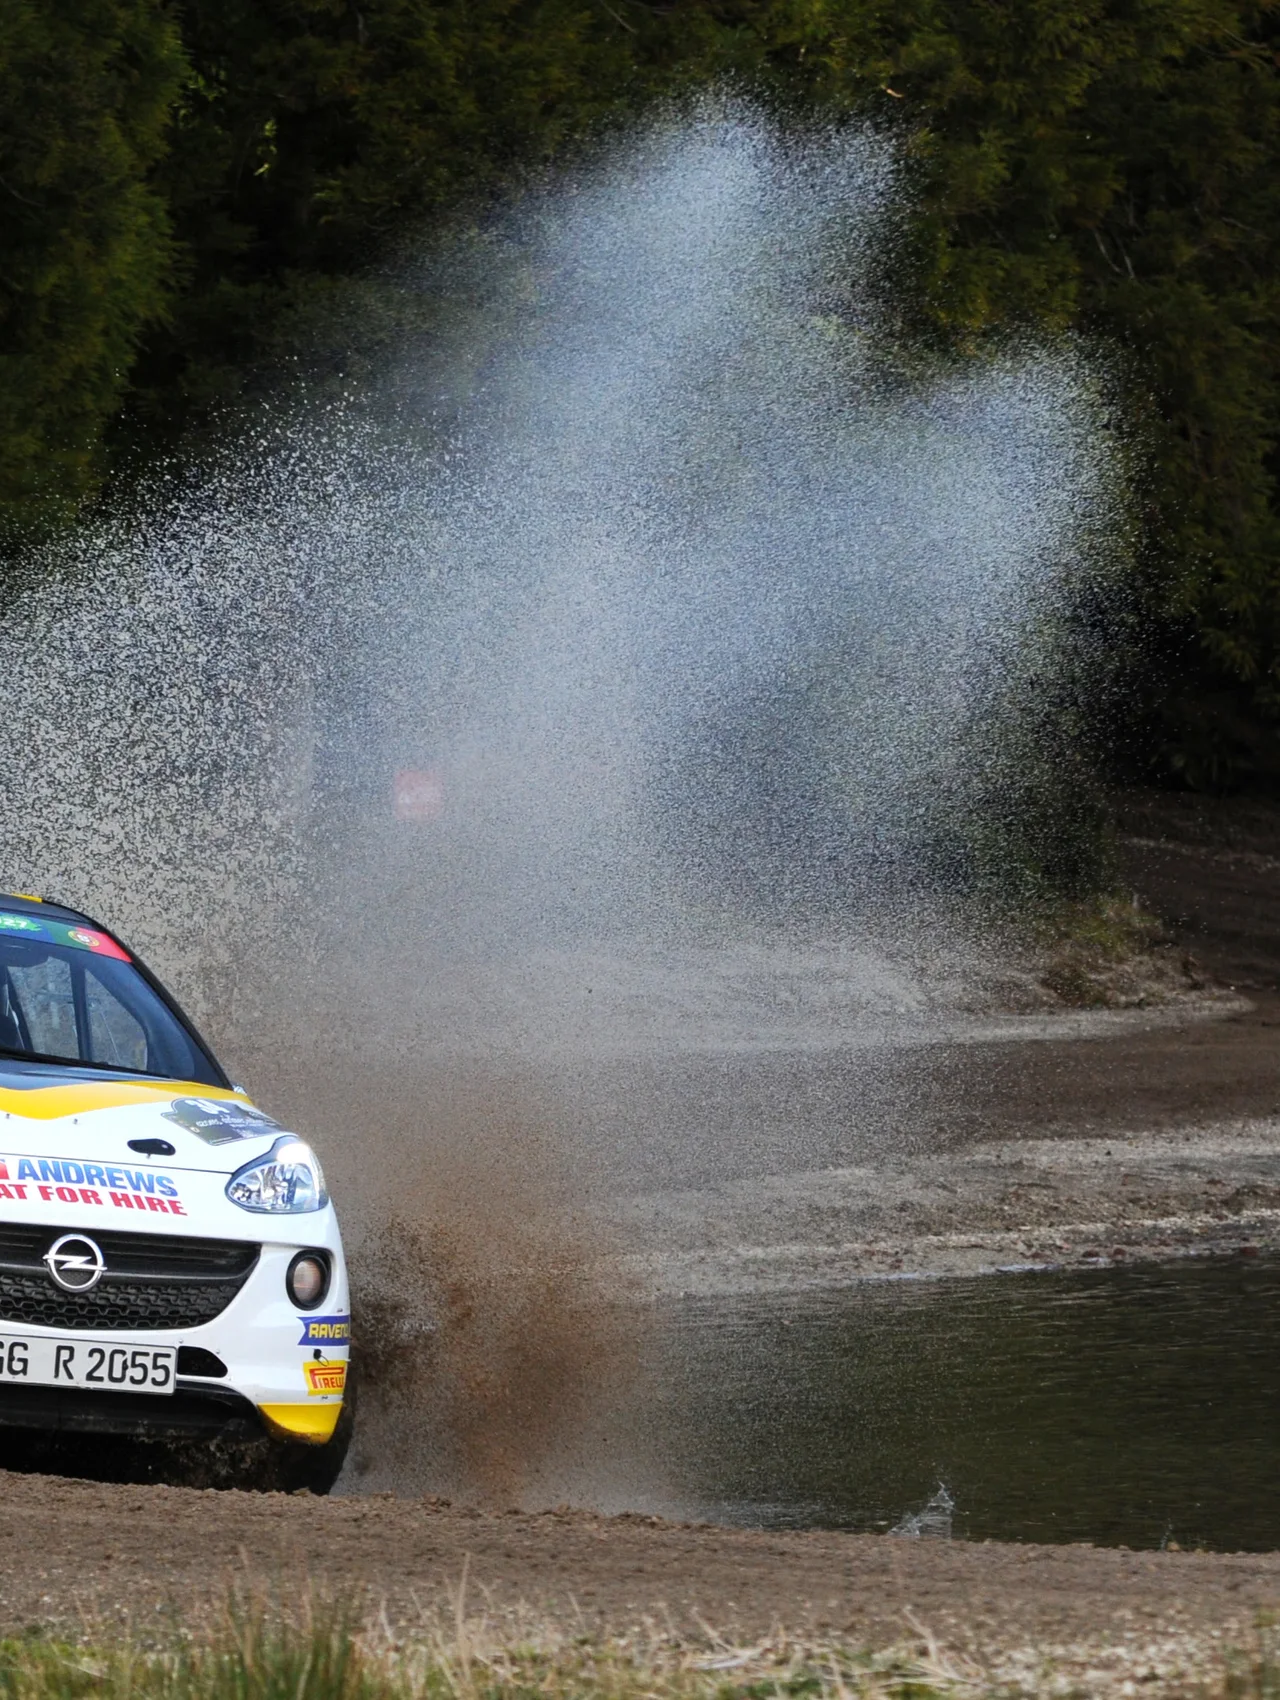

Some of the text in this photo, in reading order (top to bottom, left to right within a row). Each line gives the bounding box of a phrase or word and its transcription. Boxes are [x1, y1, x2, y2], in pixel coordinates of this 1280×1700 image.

[17, 1158, 179, 1197] ANDREWS
[37, 1185, 104, 1206] FOR
[108, 1191, 188, 1217] HIRE
[53, 1345, 75, 1380] R
[85, 1347, 172, 1387] 2055
